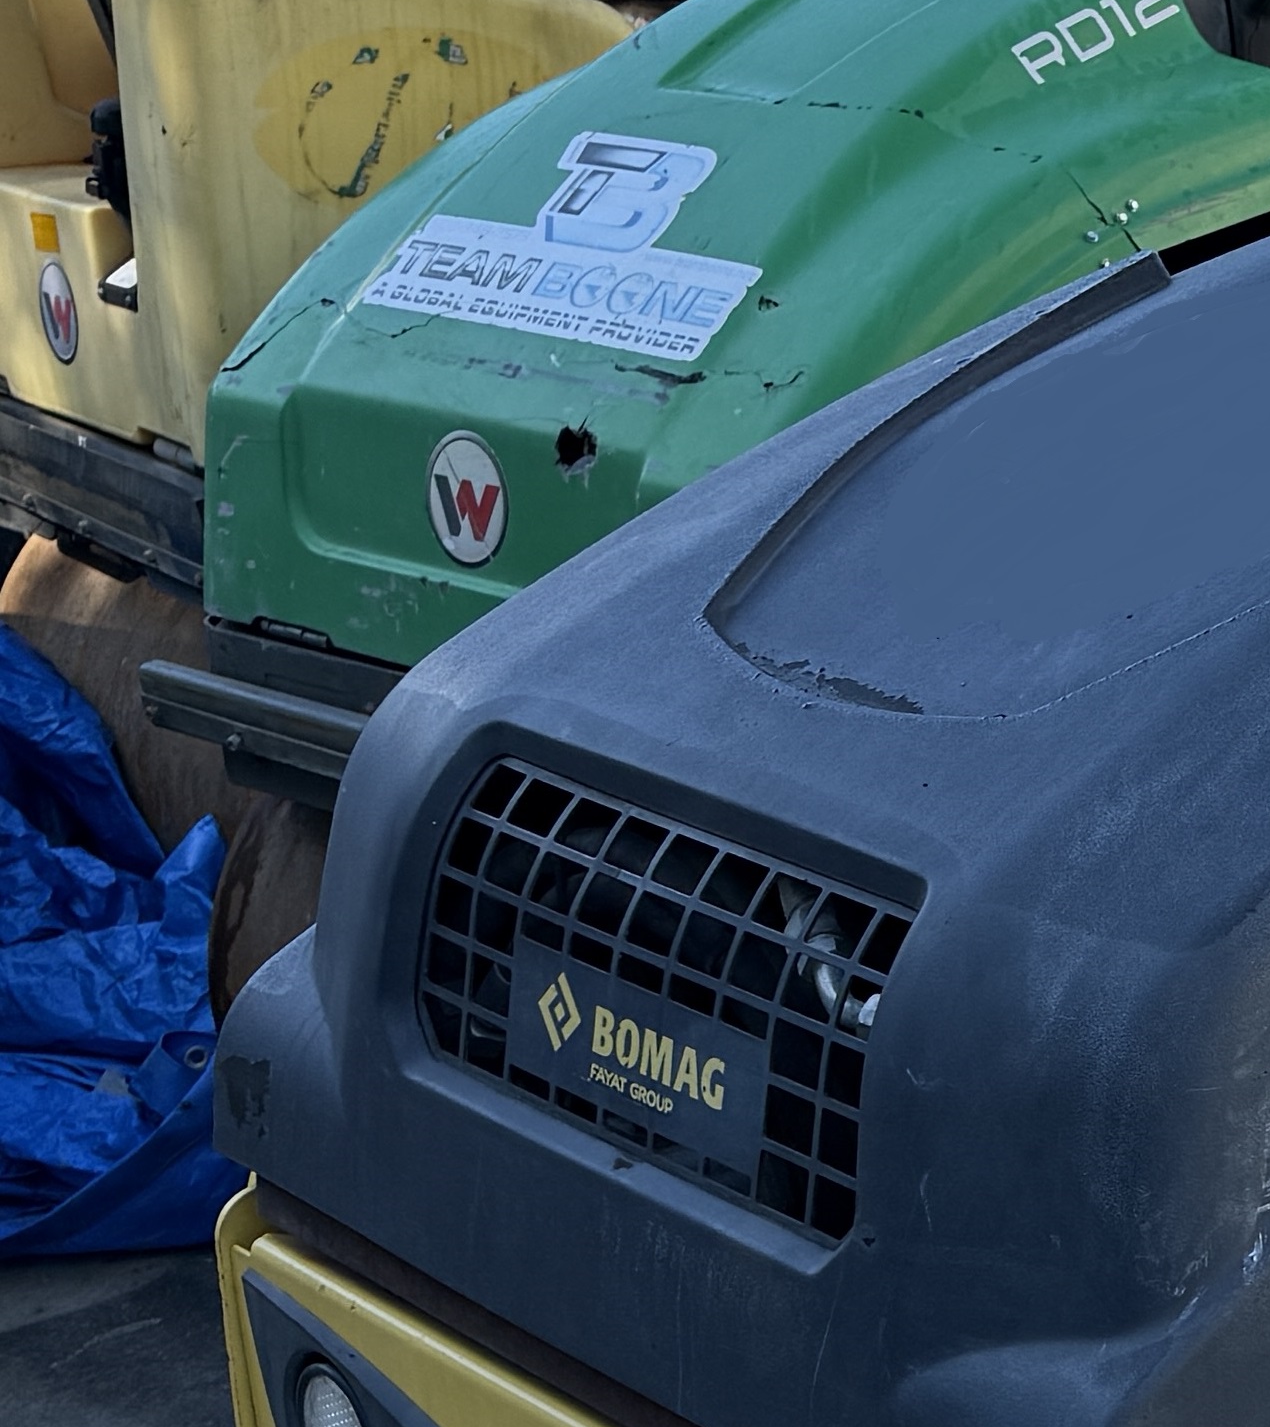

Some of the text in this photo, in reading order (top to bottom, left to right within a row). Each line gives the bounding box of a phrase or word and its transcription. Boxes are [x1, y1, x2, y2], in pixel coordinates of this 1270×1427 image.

[390, 284, 464, 313] GLOBAL
[588, 316, 701, 355] PROVIDER
[589, 1063, 674, 1114] FAYAT GROUP
[591, 1005, 726, 1111] BOMAG
